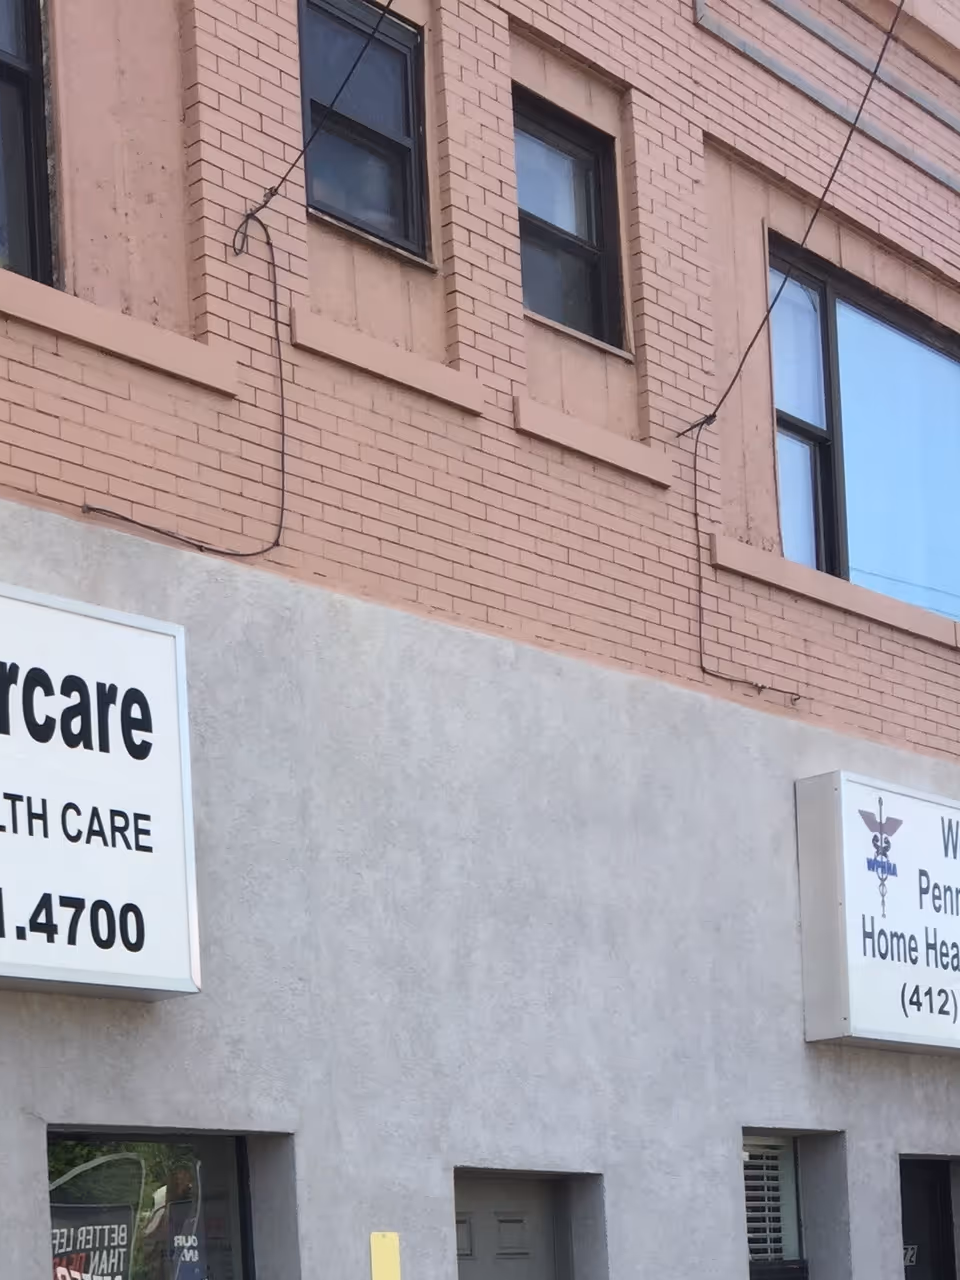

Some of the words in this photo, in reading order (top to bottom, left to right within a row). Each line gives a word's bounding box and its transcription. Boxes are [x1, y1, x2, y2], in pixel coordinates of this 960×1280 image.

[60, 802, 154, 853] CARE
[862, 914, 918, 966] Home
[900, 982, 958, 1024] (412)
